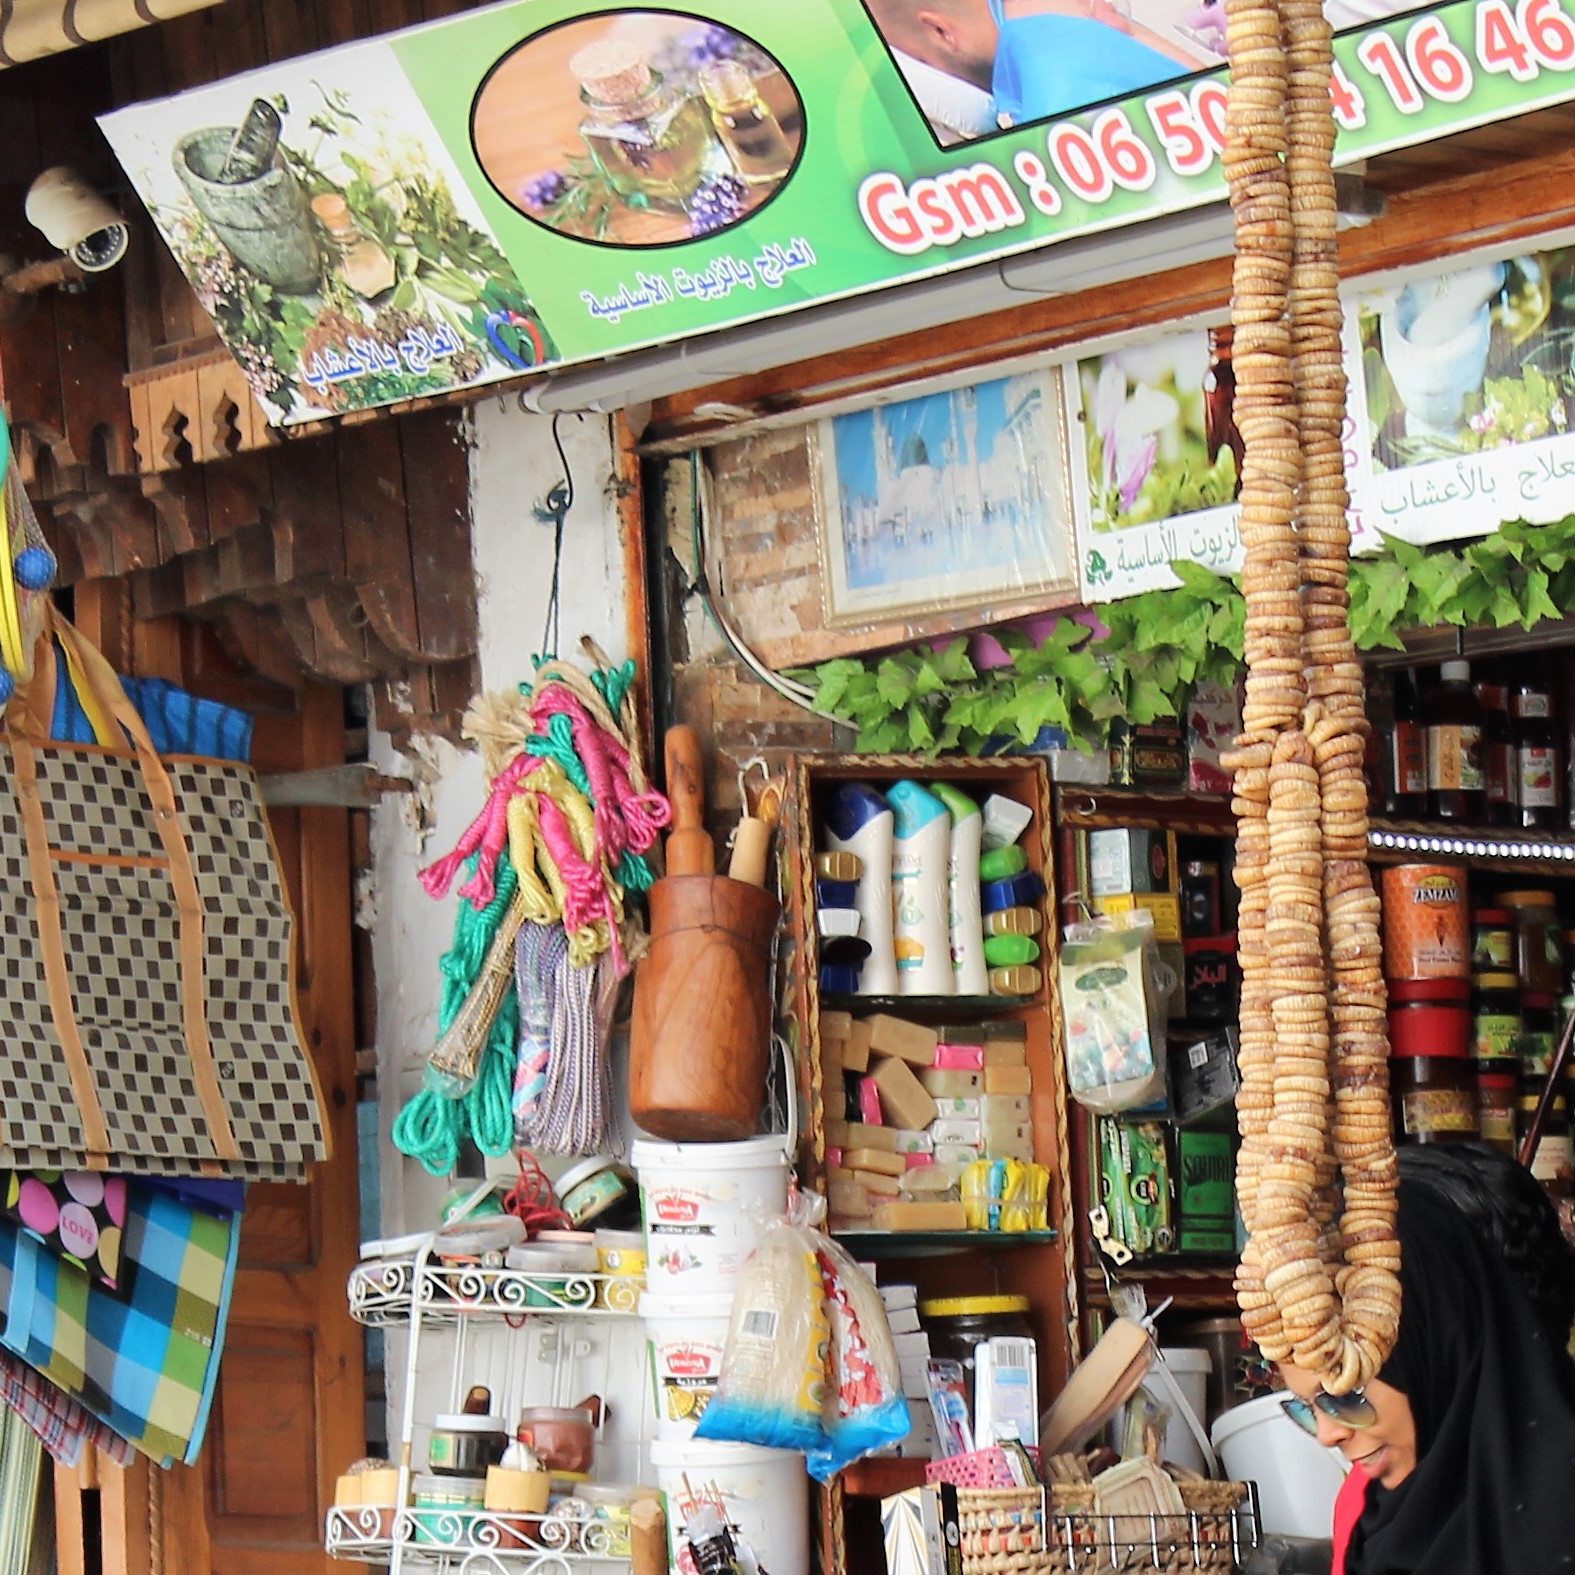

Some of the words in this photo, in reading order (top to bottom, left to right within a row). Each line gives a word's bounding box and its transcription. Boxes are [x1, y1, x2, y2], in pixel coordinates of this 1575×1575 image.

[858, 163, 1027, 257] Gsm
[1014, 148, 1061, 217] :
[1046, 107, 1156, 202] 06
[1357, 15, 1475, 116] 16
[675, 254, 758, 301] بالزيوت
[756, 235, 820, 285] العلاج
[579, 273, 673, 322] الأساسية
[302, 336, 398, 389] بالأعشاب
[400, 324, 466, 373] العلاج
[1379, 463, 1498, 521] بالأعشاب
